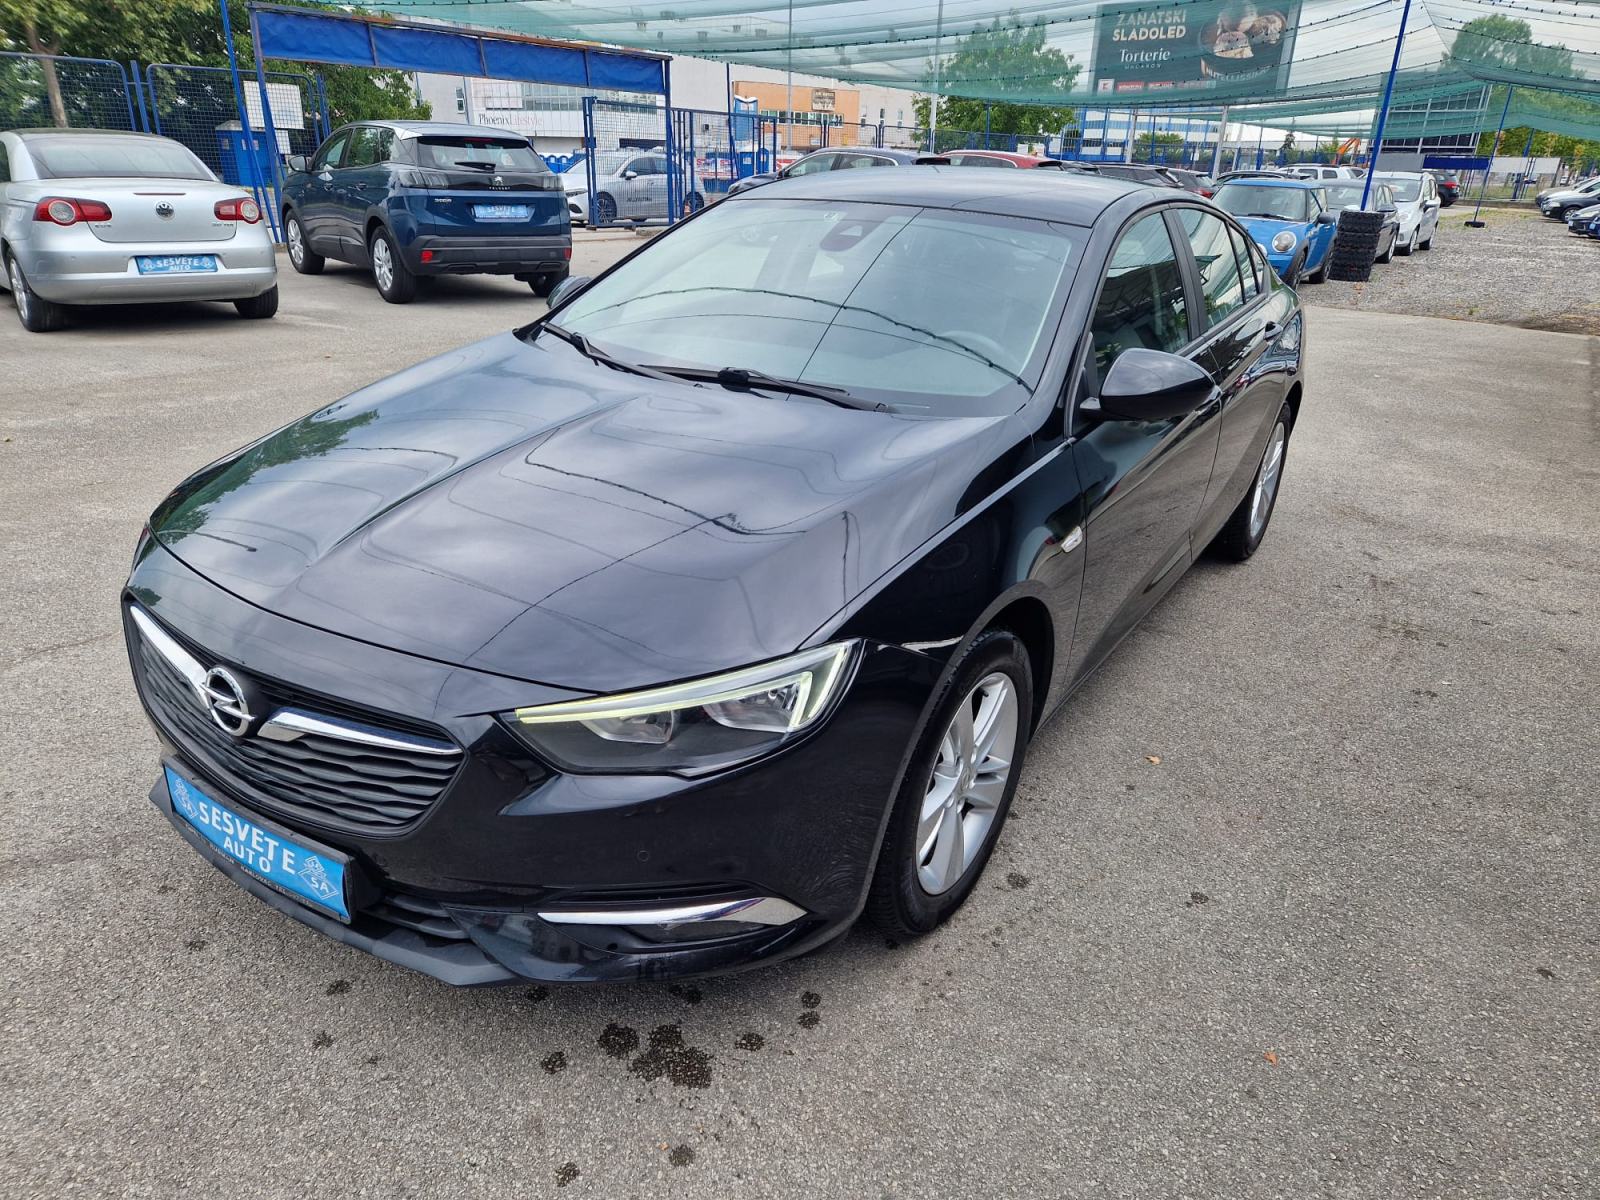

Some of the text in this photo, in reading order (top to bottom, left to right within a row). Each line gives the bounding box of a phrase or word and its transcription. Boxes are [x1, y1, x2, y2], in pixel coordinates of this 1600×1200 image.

[1117, 10, 1187, 26] ZANATSKI
[1112, 25, 1186, 41] SLADOLED
[1120, 47, 1171, 62] Torterie
[156, 256, 199, 267] SESVETE
[199, 801, 296, 875] SESVETE
[223, 836, 271, 873] AUTO
[311, 877, 329, 893] SA
